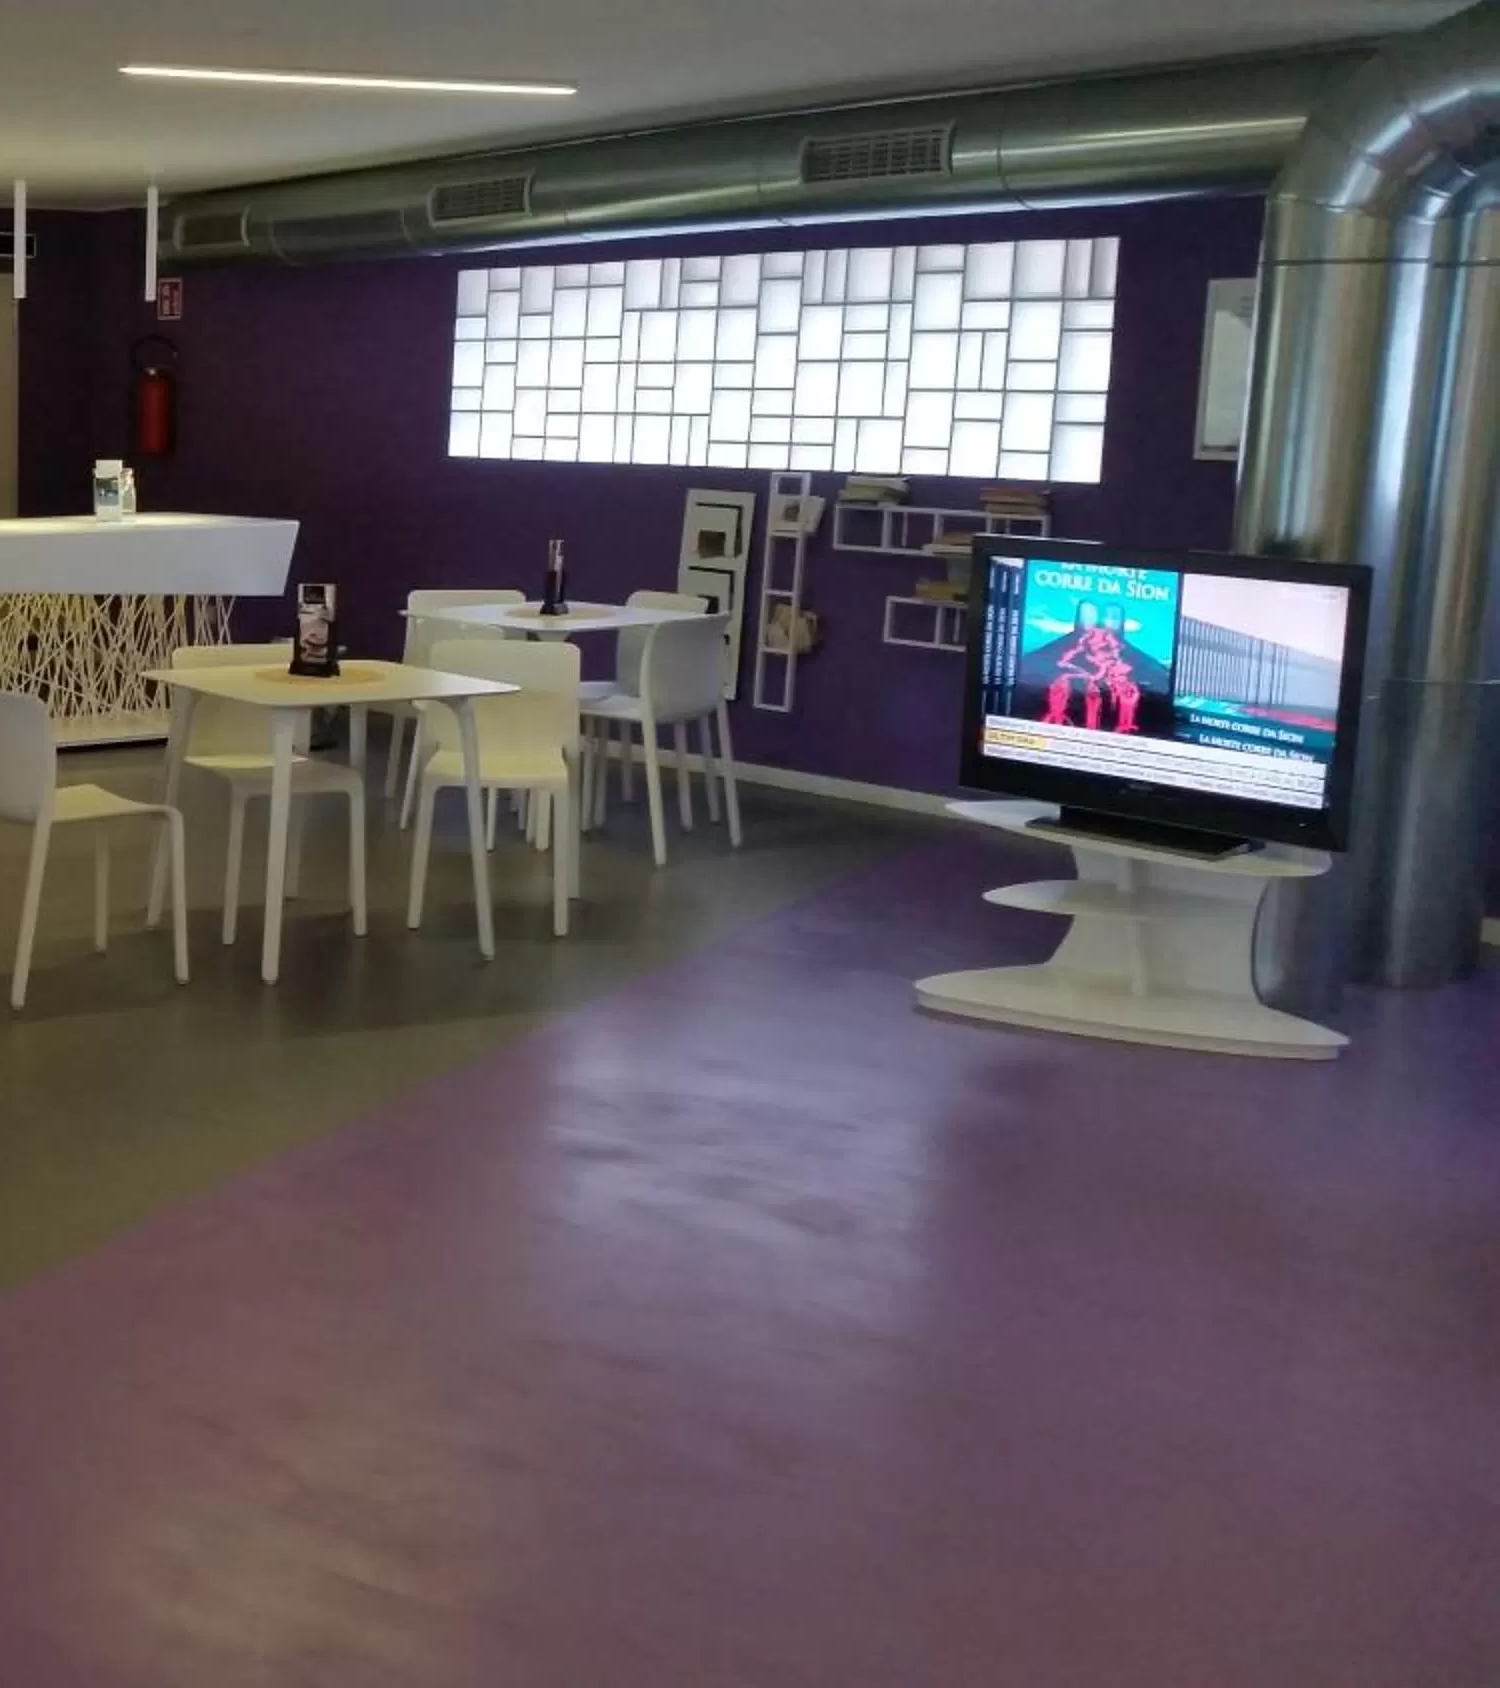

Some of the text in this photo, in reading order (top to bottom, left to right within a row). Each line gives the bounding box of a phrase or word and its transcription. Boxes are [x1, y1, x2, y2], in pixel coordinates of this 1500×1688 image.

[1035, 570, 1093, 592] CORRE
[1097, 577, 1121, 594] DA
[1126, 579, 1169, 600] SION
